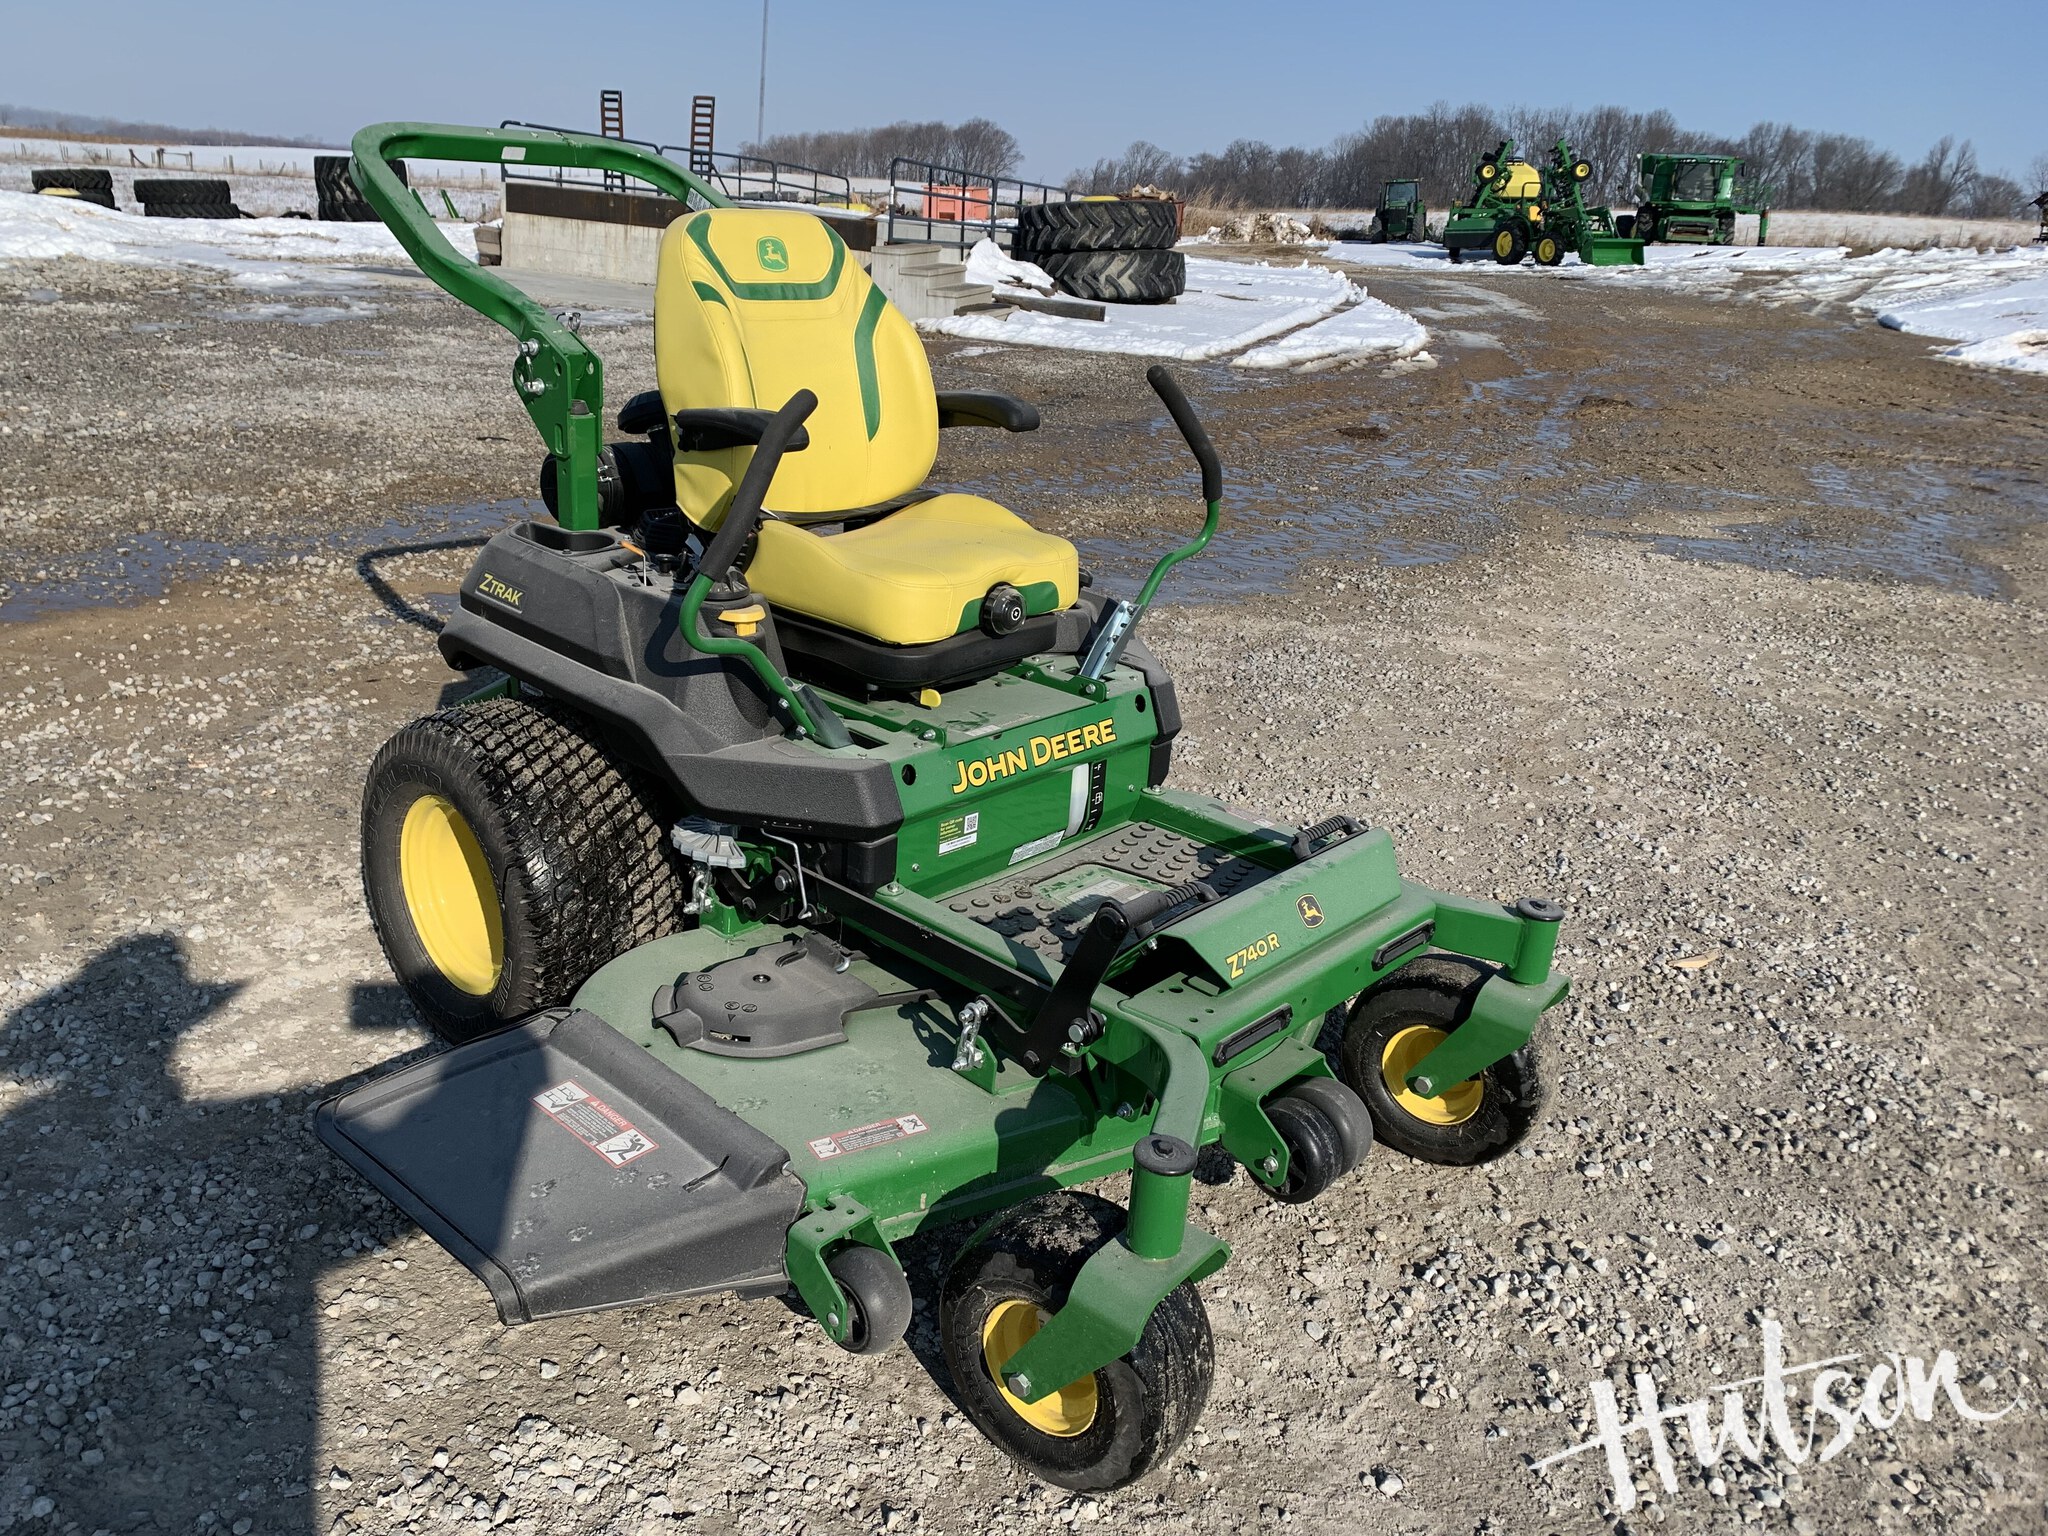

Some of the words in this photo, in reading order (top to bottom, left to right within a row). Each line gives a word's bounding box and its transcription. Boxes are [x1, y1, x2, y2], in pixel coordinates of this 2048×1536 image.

[479, 573, 523, 605] ZTRAK
[952, 747, 1028, 794] JOHN
[1029, 718, 1117, 767] DEERE
[597, 1104, 627, 1127] DANGER
